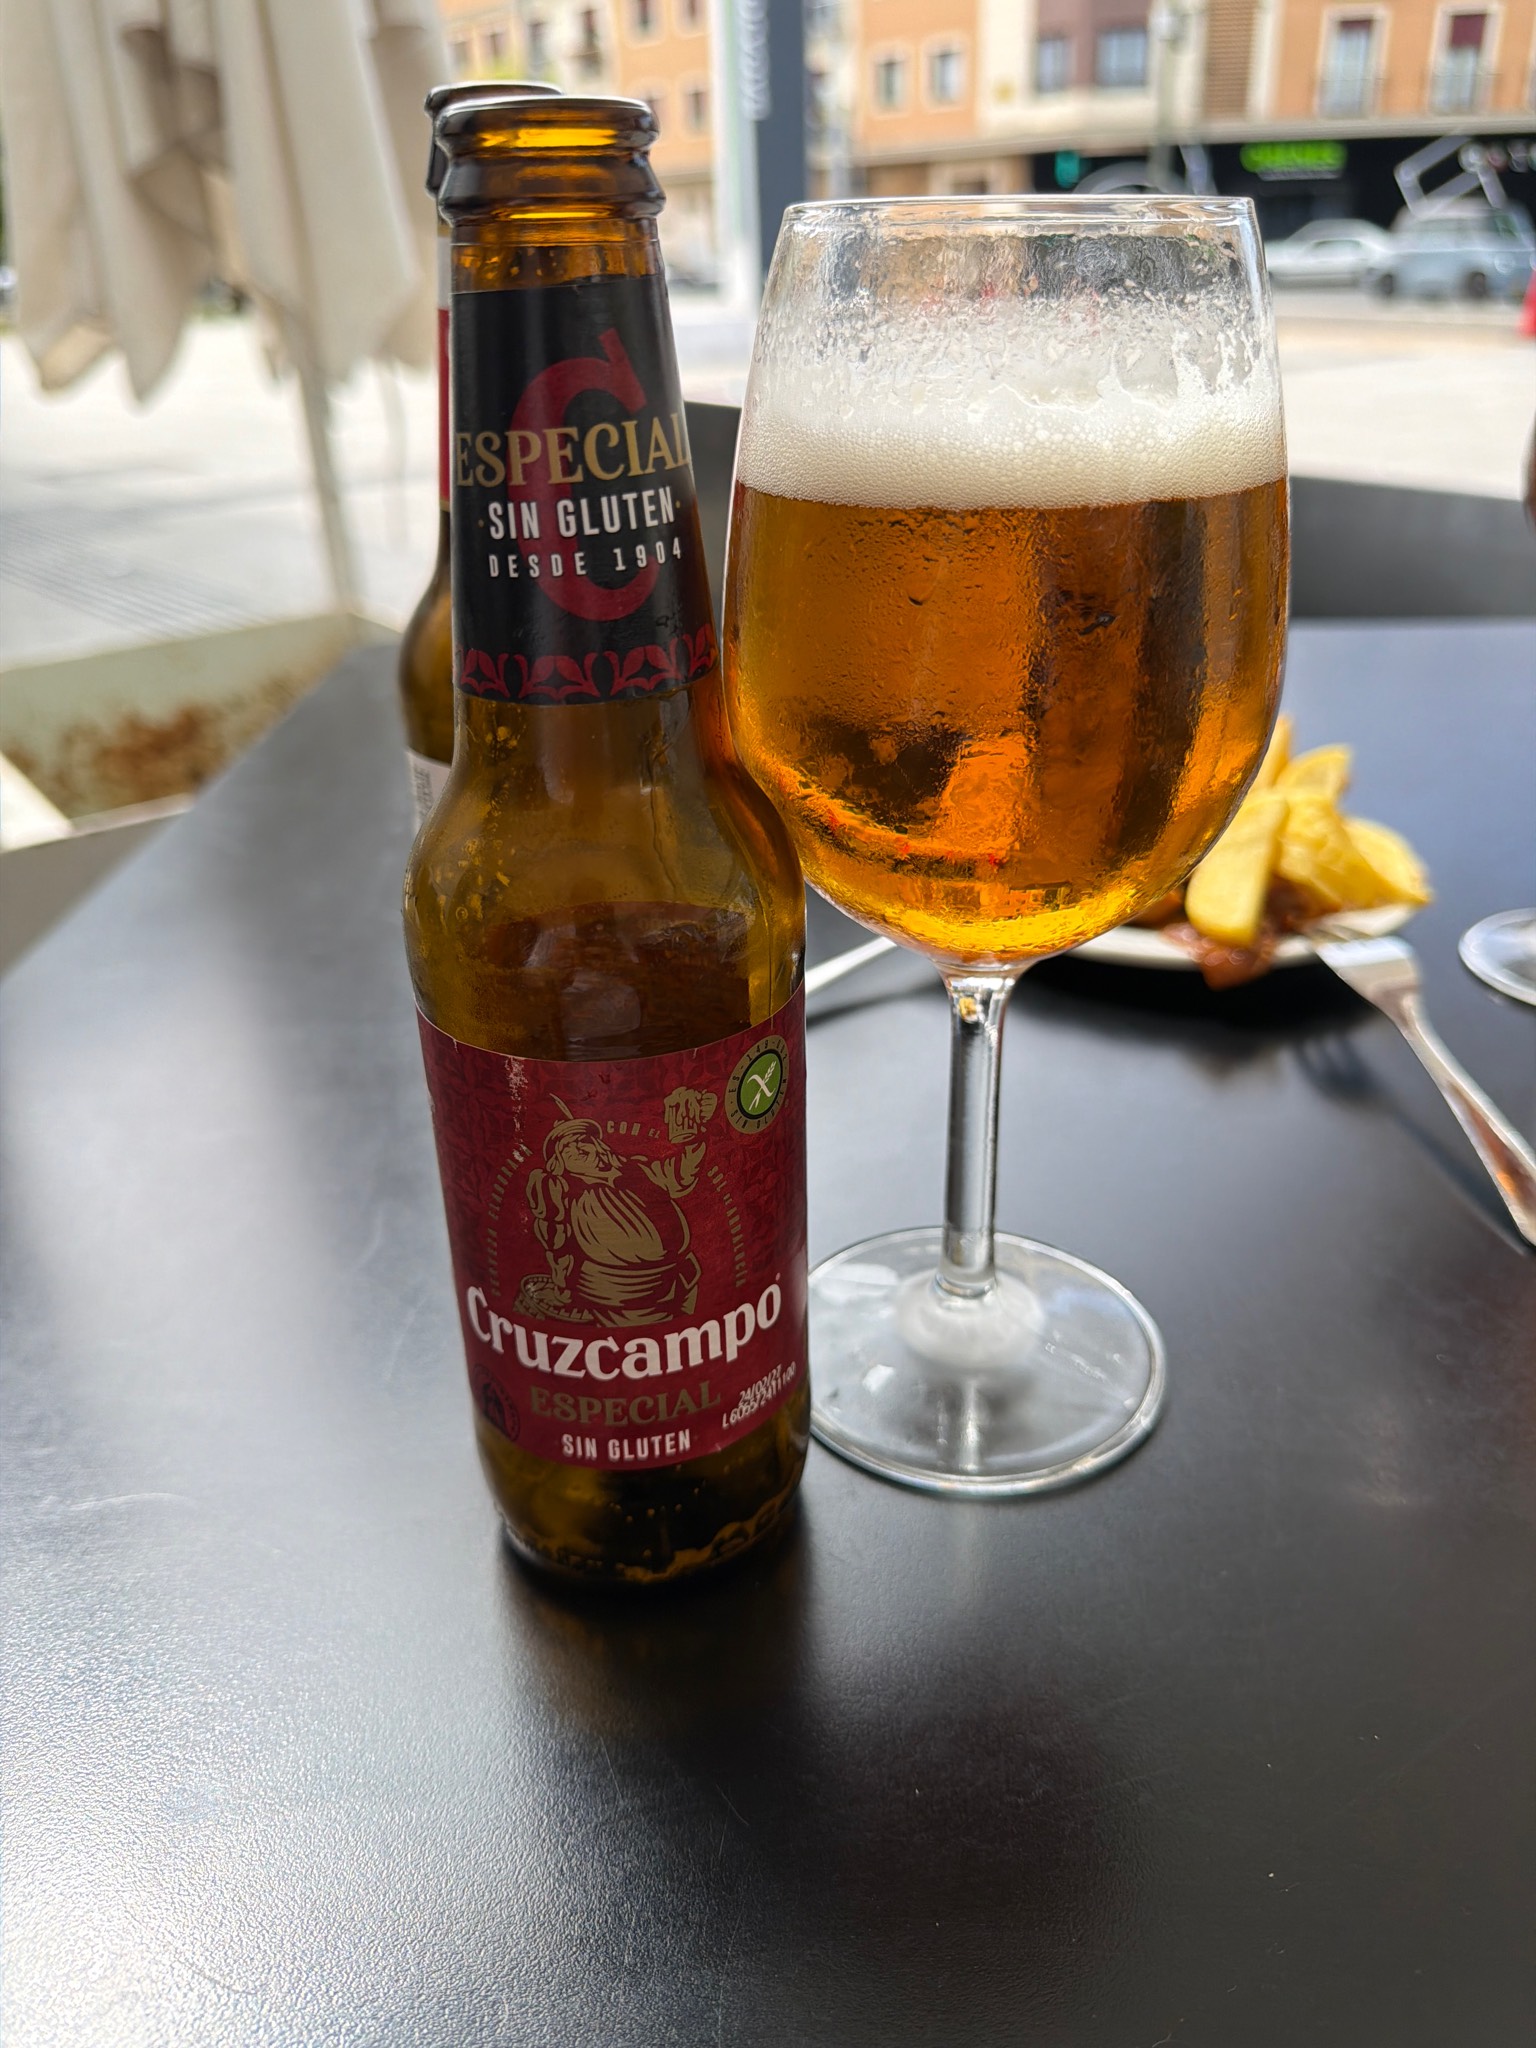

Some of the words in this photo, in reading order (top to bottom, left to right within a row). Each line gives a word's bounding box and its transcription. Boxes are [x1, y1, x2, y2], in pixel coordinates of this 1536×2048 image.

[456, 413, 691, 488] ESPECIAL
[488, 501, 540, 540] SIN
[557, 486, 675, 538] GLUTEN
[489, 552, 587, 578] DESDE
[614, 537, 682, 573] 1904
[607, 1120, 641, 1136] CON
[648, 1128, 661, 1139] EL
[707, 1165, 728, 1192] SOL
[466, 1284, 782, 1381] Cruzcampo
[529, 1380, 722, 1428] ESPECIAL
[561, 1433, 598, 1460] SIN
[607, 1428, 692, 1462] GLUTEN
